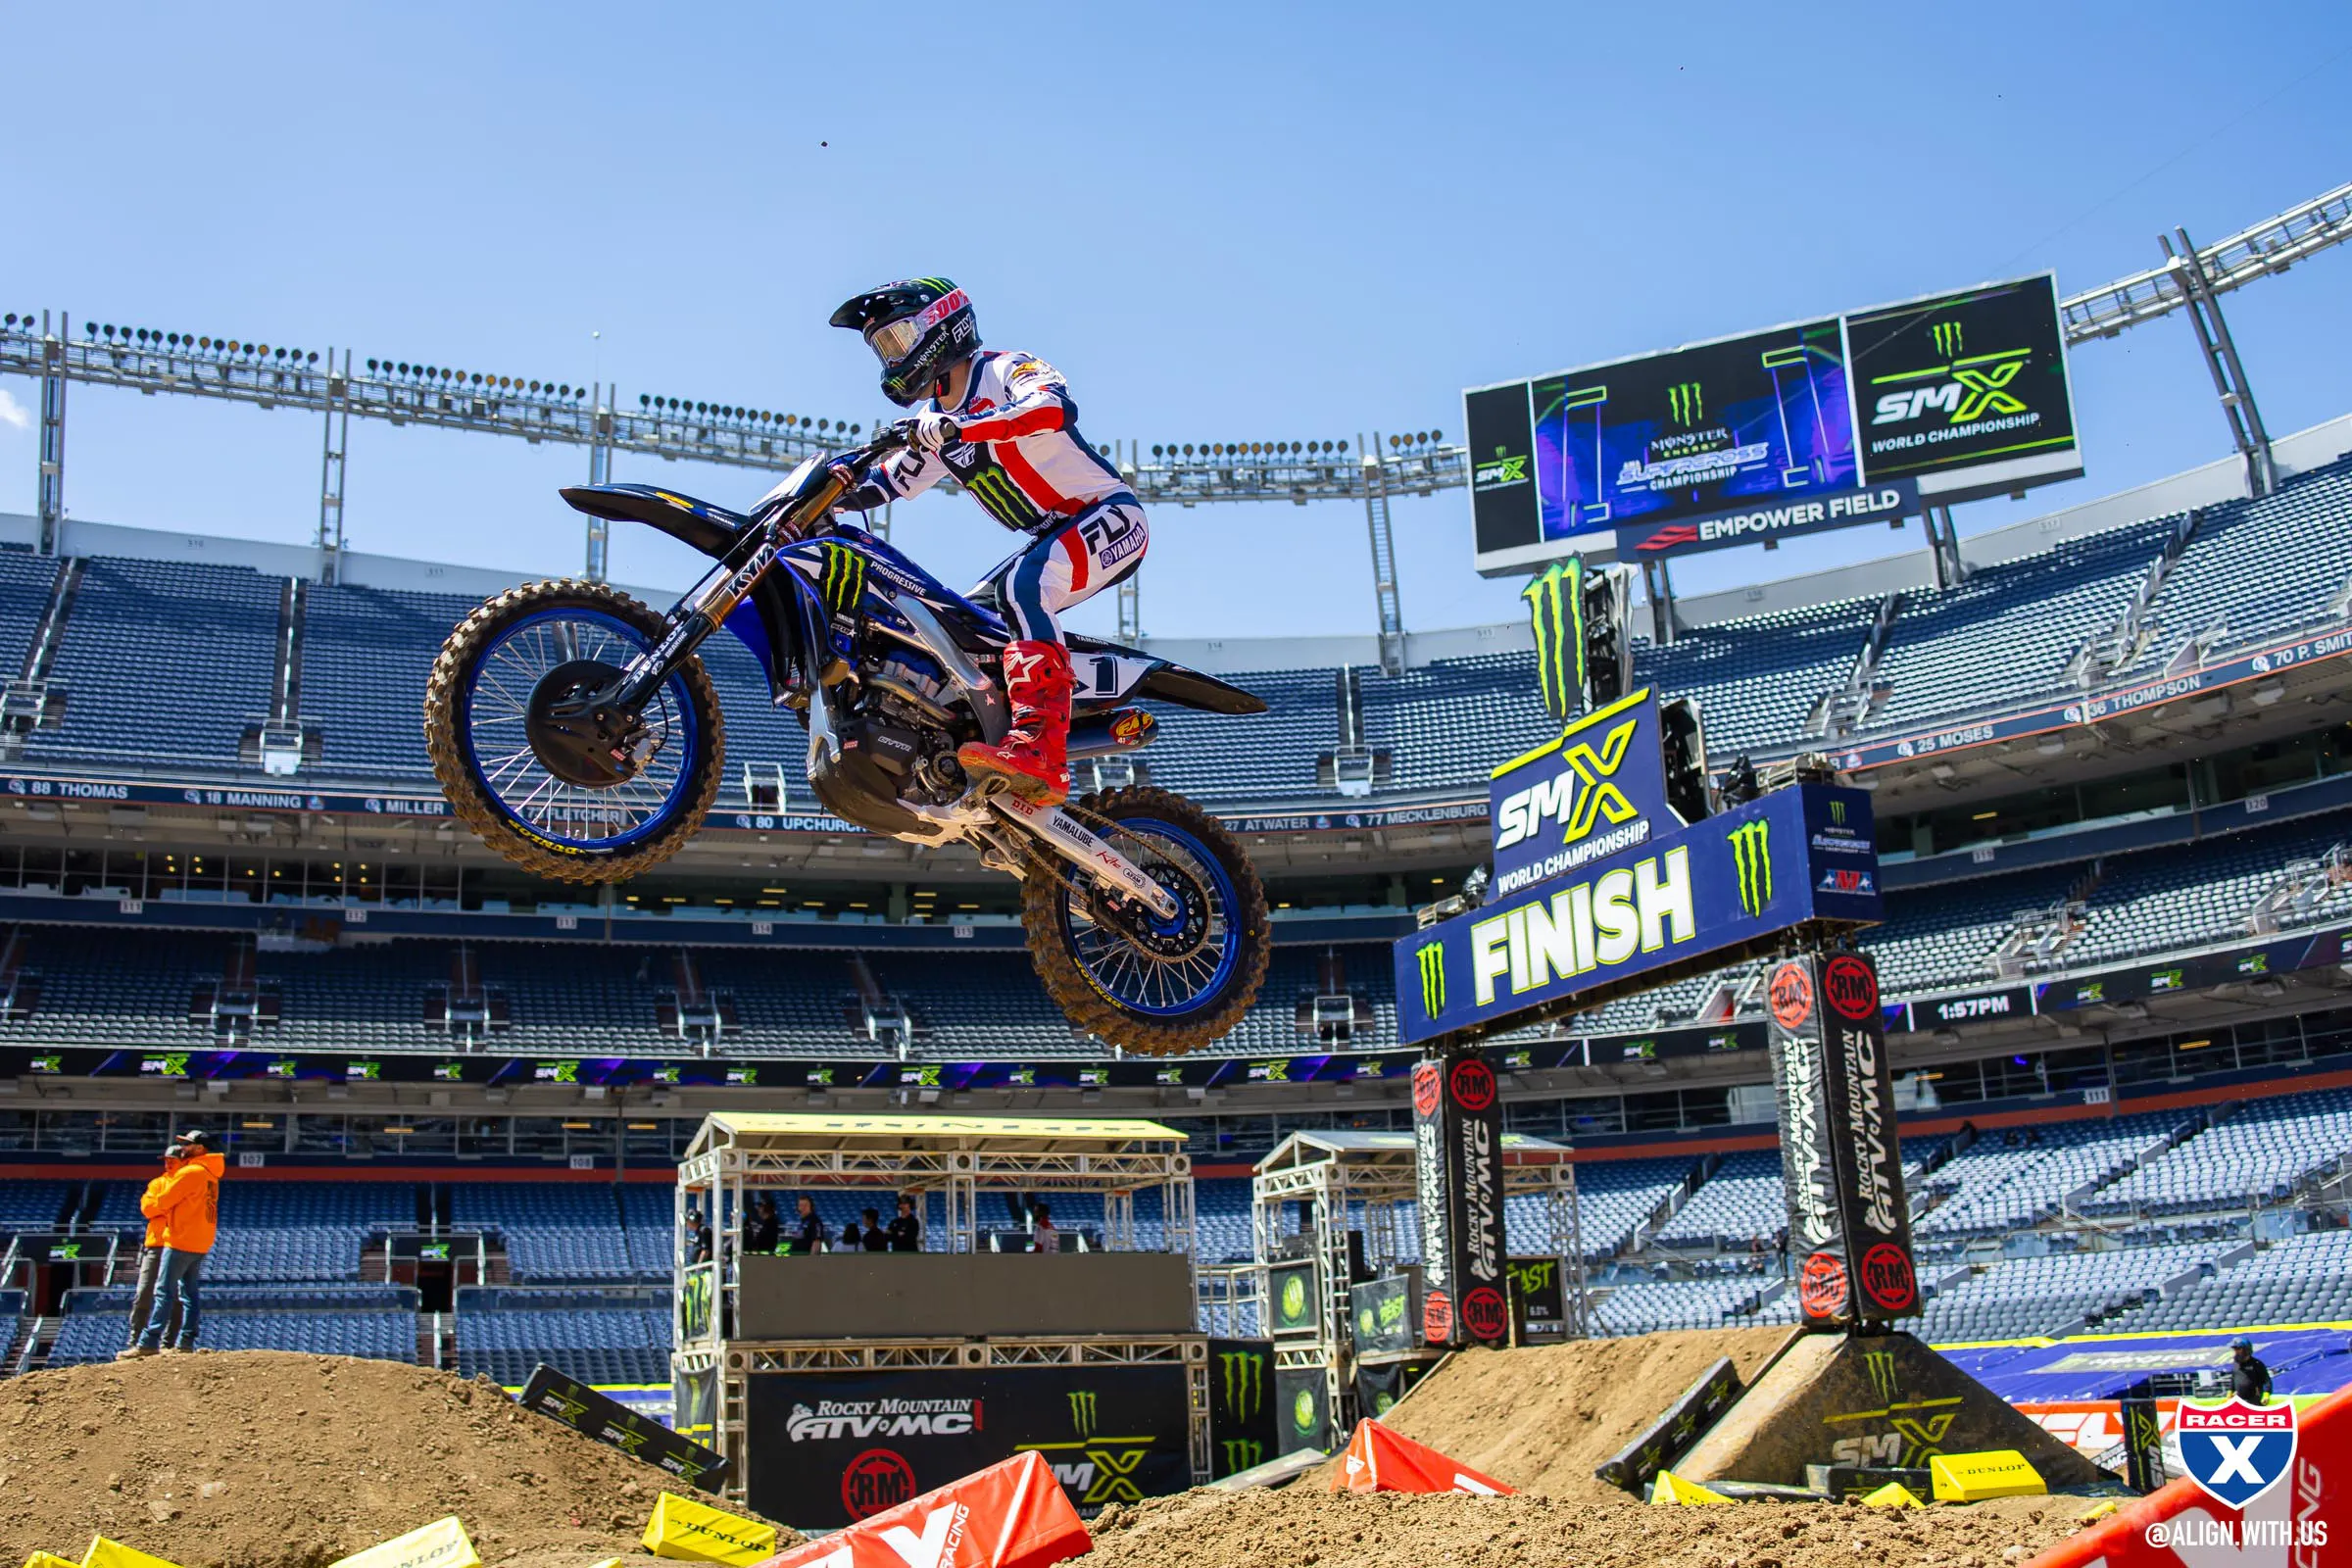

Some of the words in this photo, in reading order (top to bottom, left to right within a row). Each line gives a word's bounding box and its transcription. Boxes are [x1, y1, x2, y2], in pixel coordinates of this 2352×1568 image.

[952, 313, 972, 344] FLY
[913, 328, 951, 369] MONSTER
[1871, 361, 2028, 426] SMX
[1650, 426, 1730, 453] MONSTER
[1872, 433, 1926, 454] WORLD
[1928, 412, 2040, 443] CHAMPIONSHIP
[1475, 460, 1526, 483] SMX
[1649, 466, 1738, 491] CHAMPIONSHIP
[1698, 501, 1826, 542] EMPOWER
[1829, 489, 1901, 519] FIELD
[1079, 504, 1131, 557] FLY
[1111, 526, 1147, 561] YAMAHA
[870, 560, 927, 597] PROGRESSIVE
[1074, 634, 1108, 647] YAMAHA
[2274, 649, 2294, 666] 70
[2298, 646, 2311, 661] P.
[1089, 656, 1118, 697] 1
[2089, 703, 2106, 716] 36
[2111, 674, 2201, 710] THOMPSON
[1918, 737, 1936, 753] 25
[1939, 724, 1994, 749] MOSES
[30, 781, 51, 796] 88
[60, 782, 128, 801] THOMAS
[1496, 718, 1639, 851] SMX
[205, 791, 221, 804] 18
[226, 792, 302, 809] MANNING
[385, 799, 445, 816] MILLER
[1367, 812, 1384, 826] 77
[1387, 803, 1488, 824] MECKLENBURG
[547, 808, 620, 823] FLETCHER
[756, 815, 774, 830] 80
[1226, 819, 1240, 832] 27
[1245, 817, 1309, 832] ATWATER
[508, 818, 578, 856] DUNLOP
[1052, 814, 1096, 849] YAMALUBE
[1497, 868, 1543, 899] WORLD
[1544, 819, 1649, 878] CHAMPIONSHIP
[1471, 845, 1695, 1007] FINISH
[1936, 995, 2010, 1020] 1:57PM
[141, 1056, 189, 1076] SMX
[347, 1064, 379, 1079] SMX
[535, 1064, 578, 1083] SMX
[901, 1069, 940, 1087] SMX
[1248, 1063, 1288, 1081] SMX
[1842, 1029, 1867, 1140] MOUNTAIN
[2088, 1087, 2108, 1102] 111
[1461, 1117, 1478, 1201] MOUNTAIN
[1854, 1141, 1874, 1200] ROCKY
[1467, 1203, 1481, 1254] ROCKY
[541, 1396, 587, 1426] SMX
[816, 1399, 876, 1416] ROCKY
[878, 1398, 972, 1414] MOUNTAIN
[600, 1426, 647, 1454] SMX
[1831, 1413, 1957, 1470] SMX
[659, 1456, 706, 1485] SMX
[1054, 1449, 1147, 1503] MX
[1967, 1462, 2027, 1476] DUNLOP
[686, 1521, 768, 1553] DUNLOP
[941, 1502, 970, 1568] RACING
[392, 1540, 461, 1568] NLOP
